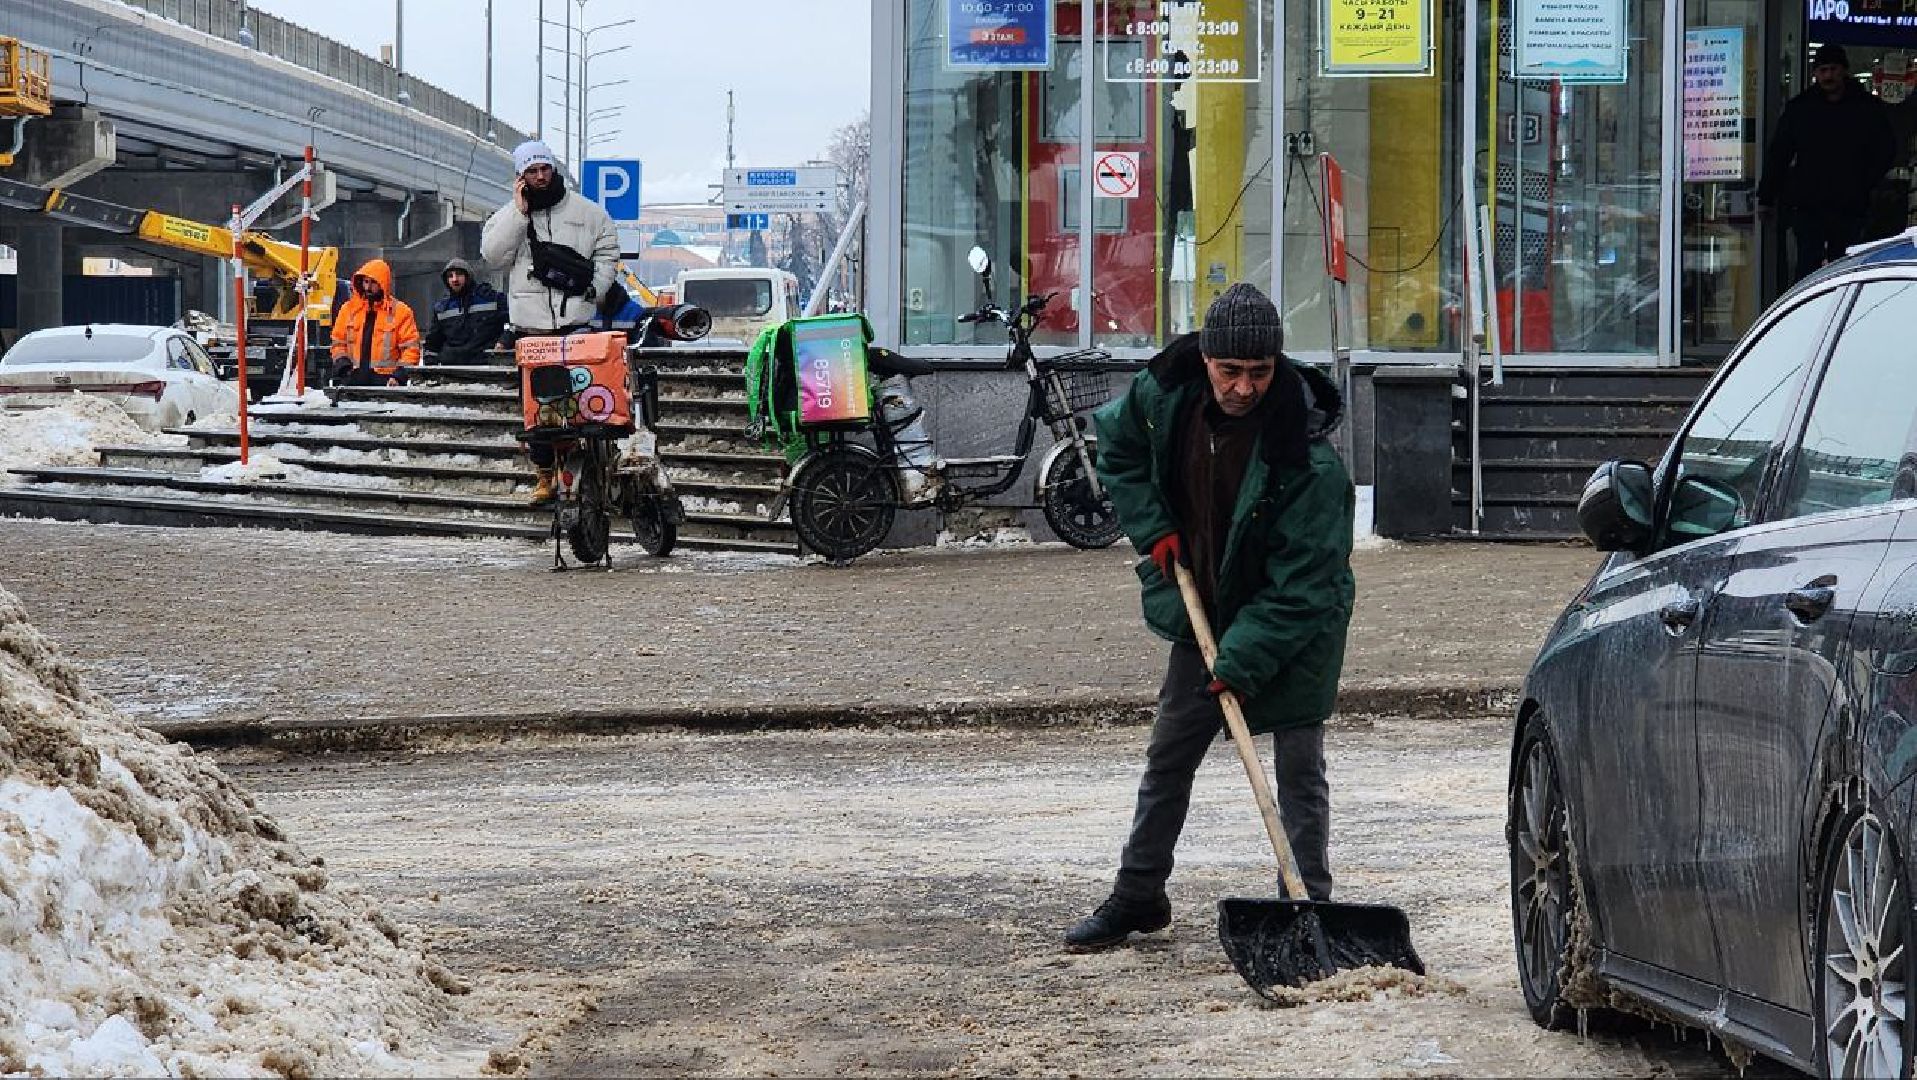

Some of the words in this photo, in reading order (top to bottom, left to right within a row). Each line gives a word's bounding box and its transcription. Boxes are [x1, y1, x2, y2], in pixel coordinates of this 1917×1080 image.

[961, 3, 992, 12] 10:00
[1003, 3, 1034, 12] 21:00
[1137, 21, 1169, 36] 8:00
[1198, 21, 1239, 36] 23:00
[1134, 58, 1169, 73] 8:00
[1198, 59, 1239, 74] 23:00
[598, 165, 631, 217] P
